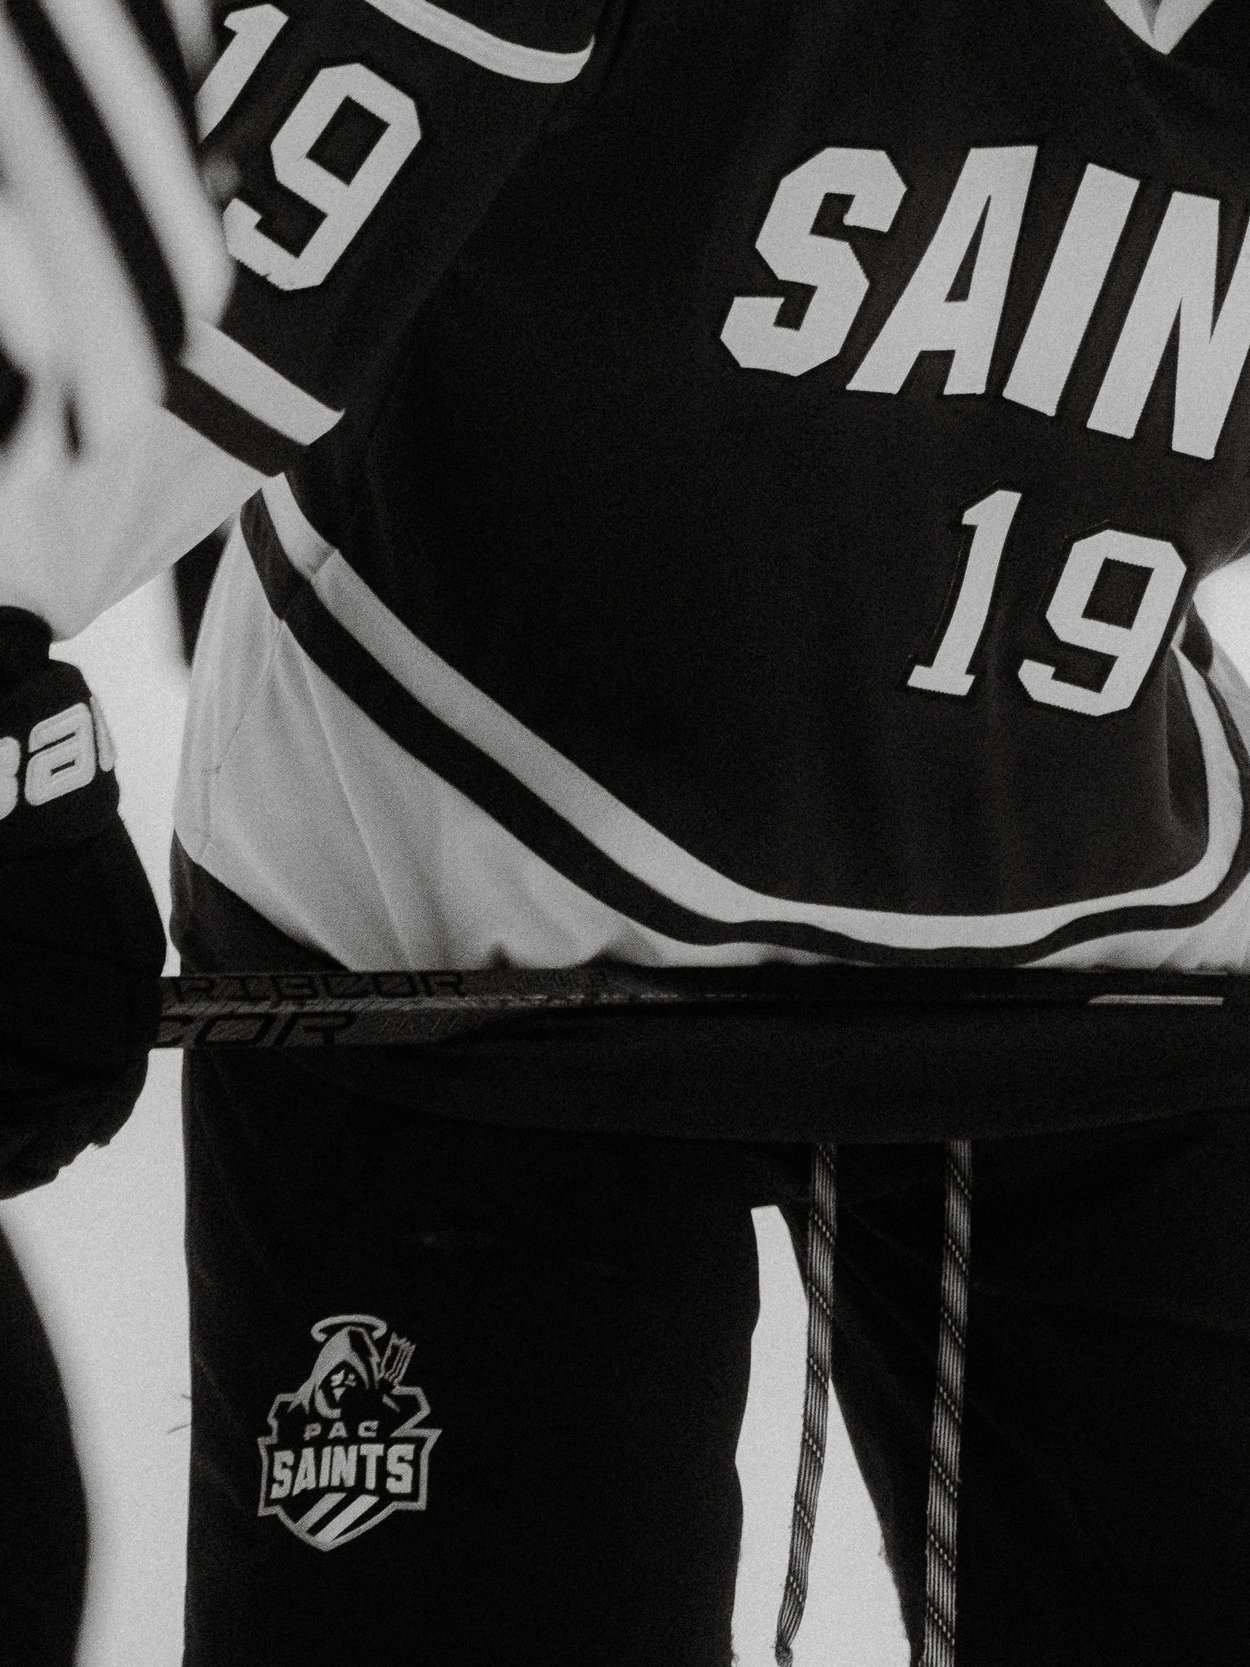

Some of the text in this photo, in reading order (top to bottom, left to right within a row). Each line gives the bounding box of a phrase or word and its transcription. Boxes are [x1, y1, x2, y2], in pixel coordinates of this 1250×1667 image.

[196, 3, 421, 292] 19
[906, 488, 1188, 718] 19
[170, 971, 467, 1003] RIBCOR
[303, 1419, 380, 1441] PAC
[269, 1442, 415, 1501] SAINTS
